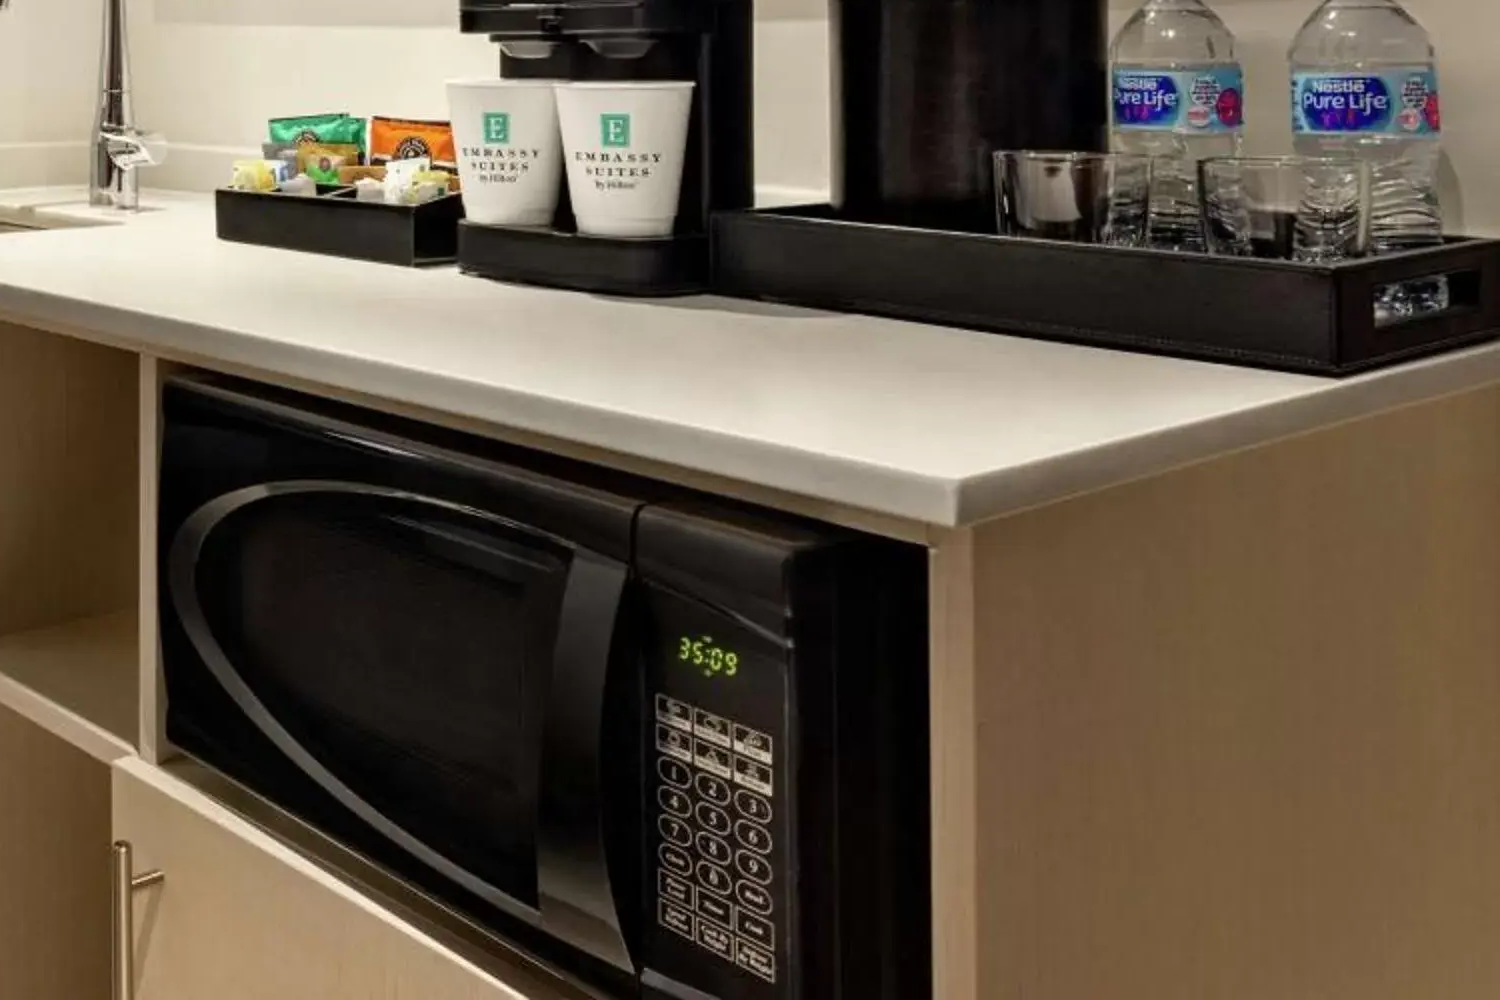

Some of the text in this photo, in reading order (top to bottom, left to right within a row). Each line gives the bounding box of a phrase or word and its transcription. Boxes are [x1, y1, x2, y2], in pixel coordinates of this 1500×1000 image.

[1143, 89, 1177, 112] Life
[1303, 93, 1345, 109] Pure
[1349, 92, 1387, 116] Life
[462, 147, 540, 159] EMBASSY
[575, 151, 662, 163] EMBASSY
[471, 161, 529, 171] SUITES
[585, 166, 651, 177] SUITES
